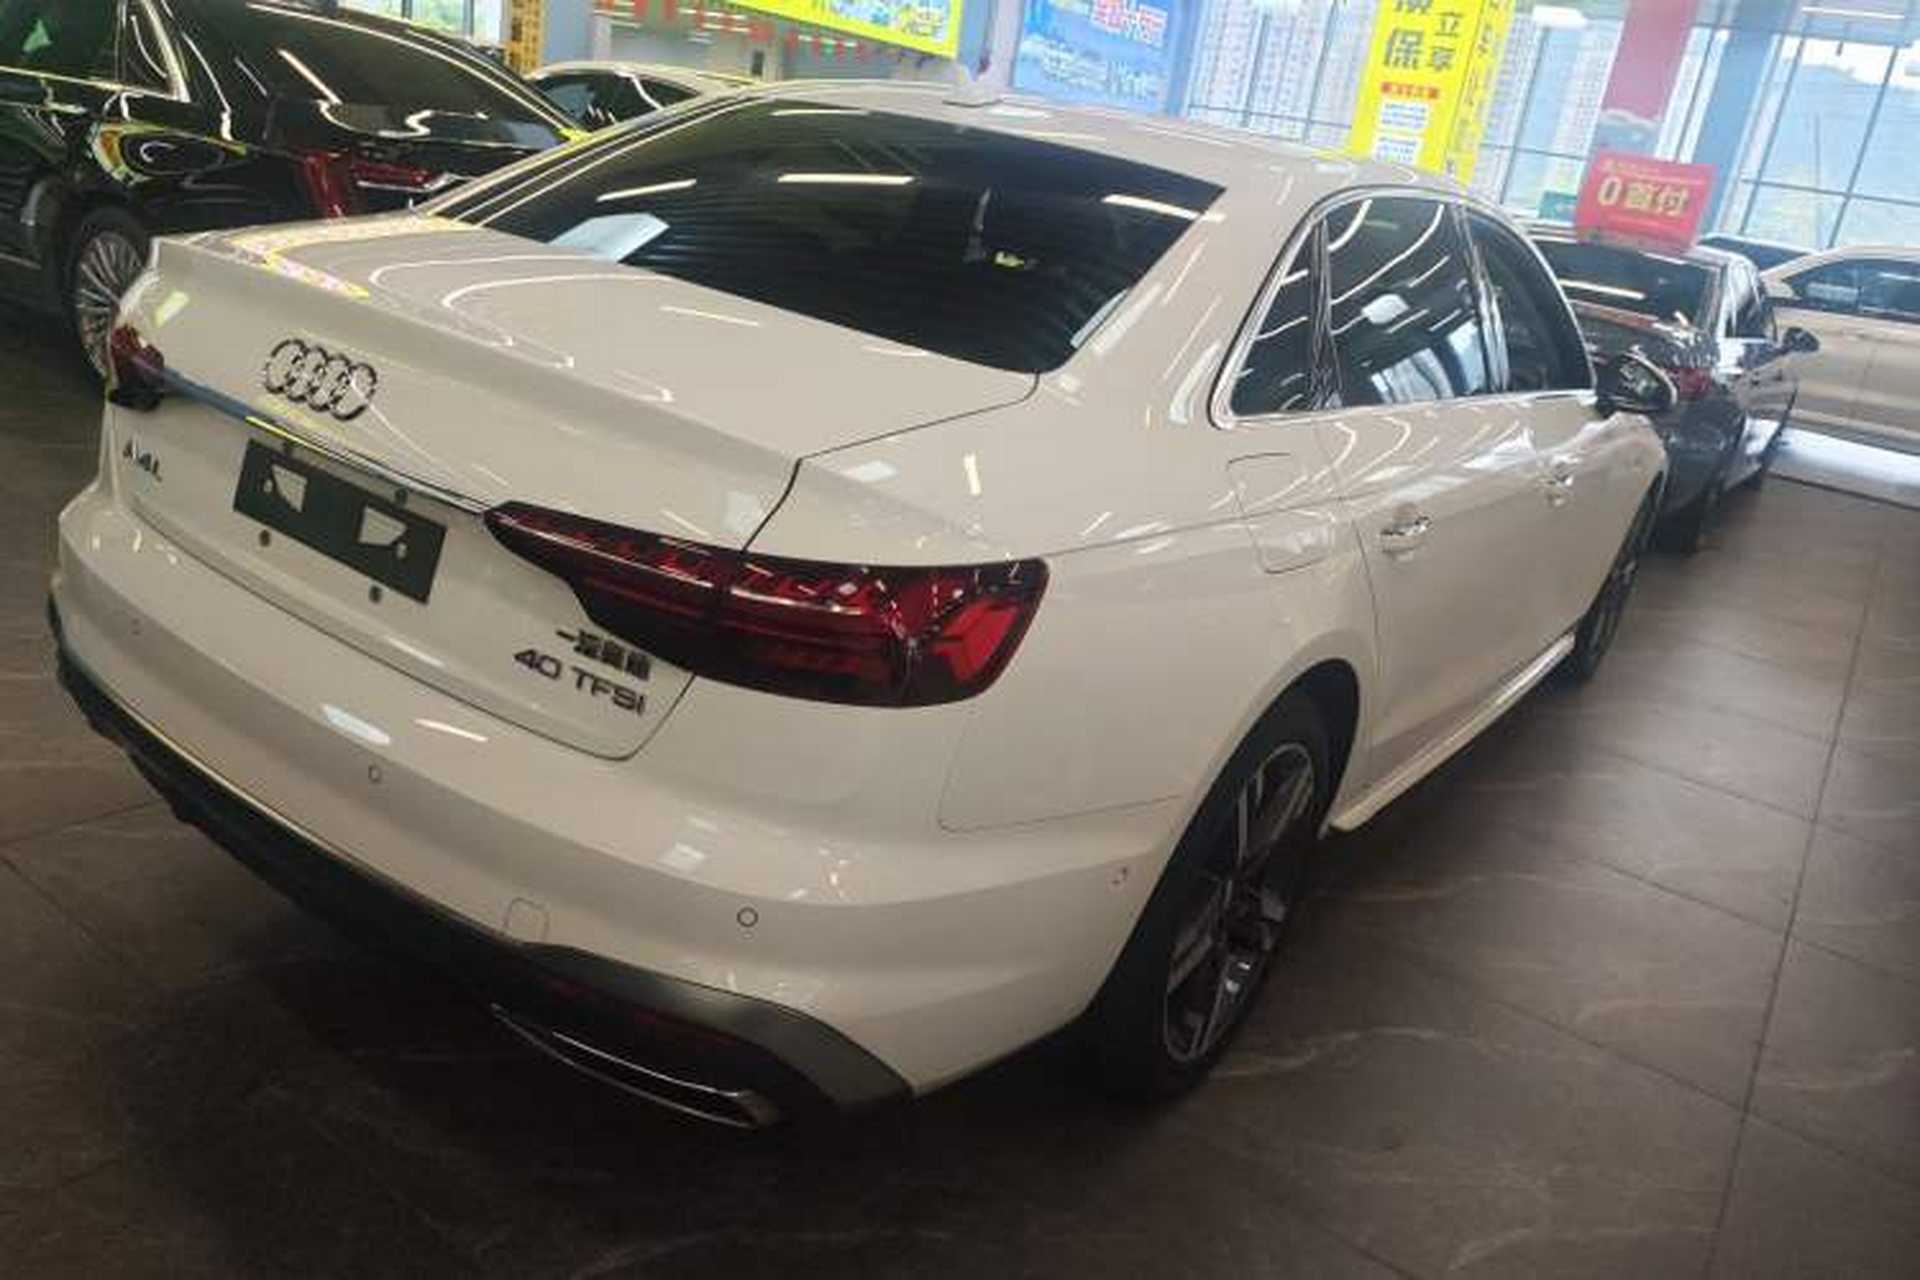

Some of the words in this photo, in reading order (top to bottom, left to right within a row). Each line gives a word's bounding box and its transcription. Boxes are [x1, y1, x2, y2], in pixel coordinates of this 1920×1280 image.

[122, 437, 162, 483] A4L
[513, 648, 562, 680] 40
[571, 665, 646, 717] TFSI
